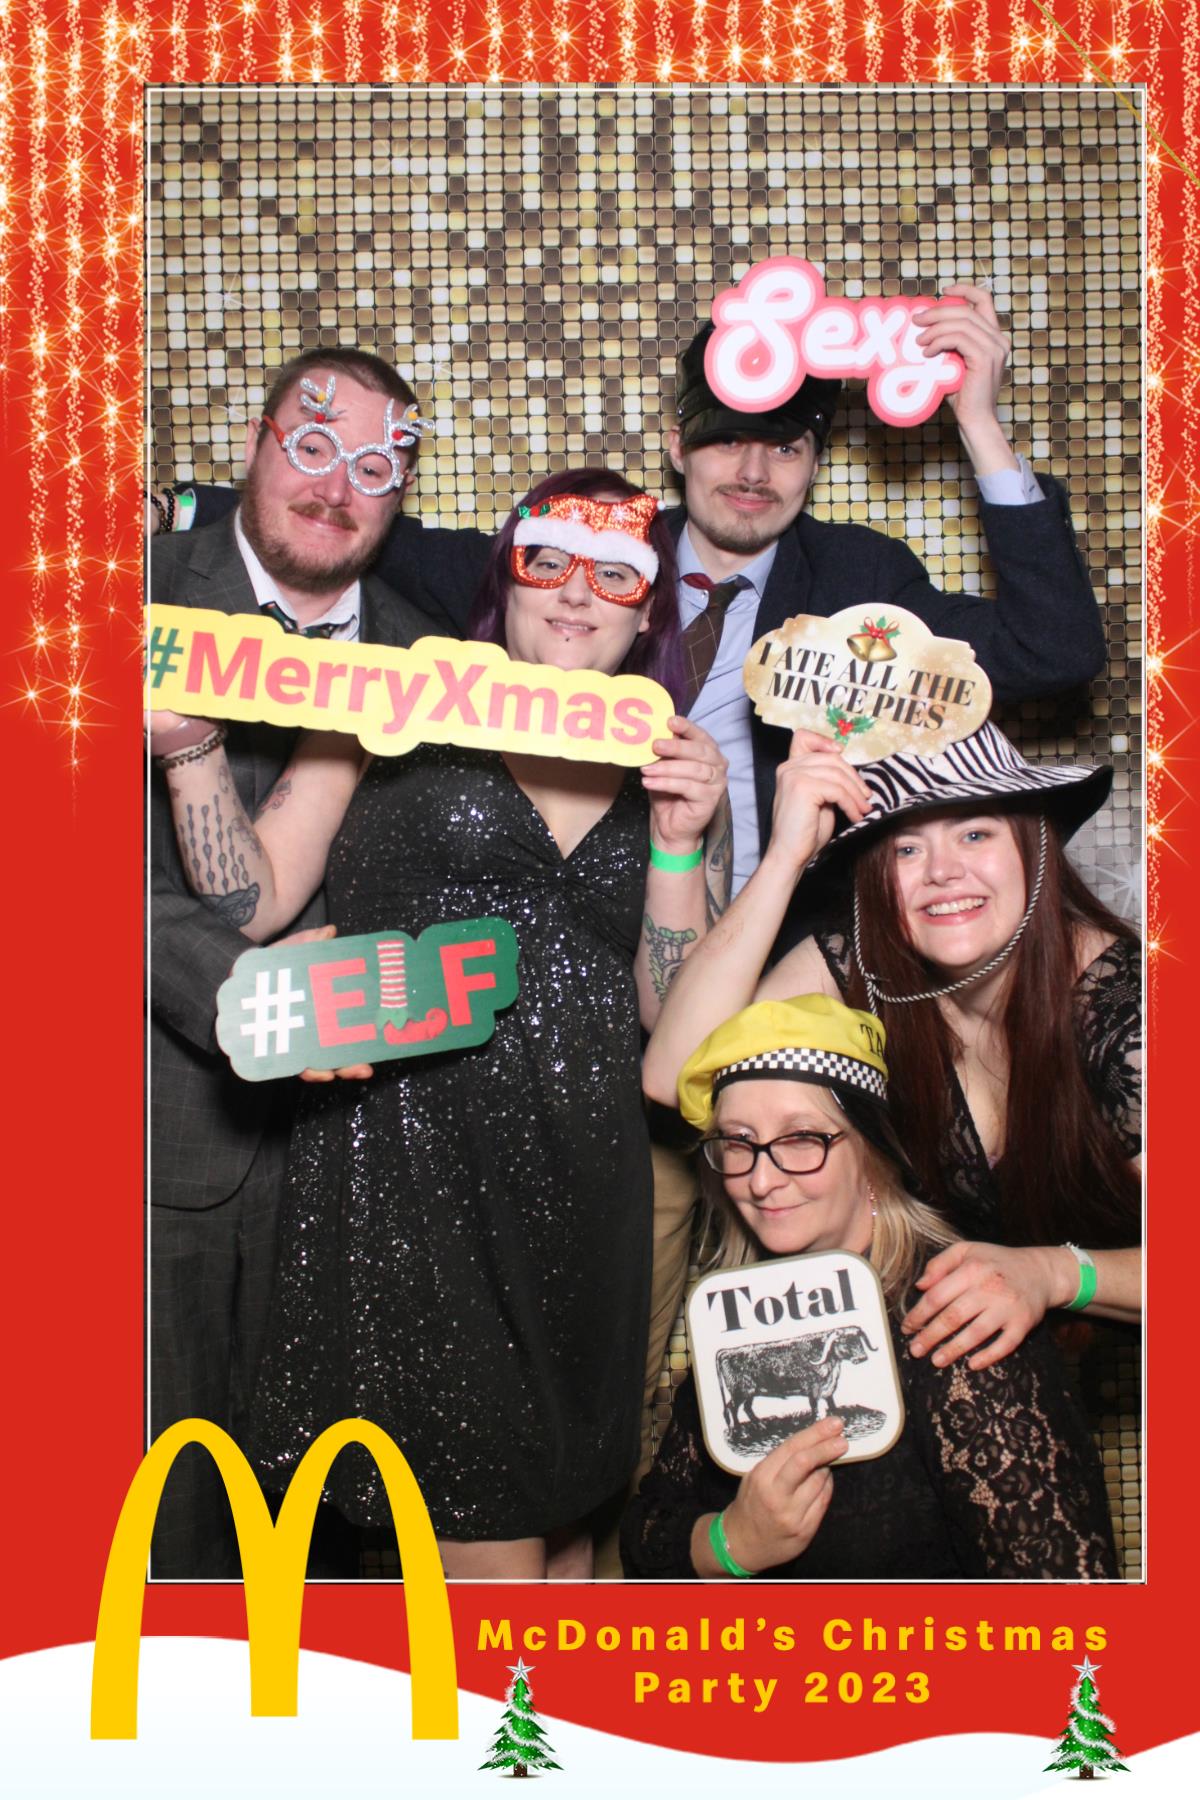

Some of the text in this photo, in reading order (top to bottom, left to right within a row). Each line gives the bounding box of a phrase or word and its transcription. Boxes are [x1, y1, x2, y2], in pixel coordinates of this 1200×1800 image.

[716, 266, 957, 414] Sexy
[145, 626, 653, 746] #MerryXmas
[758, 642, 977, 706] I ATE ALL THE
[767, 672, 947, 730] MINCE PIES
[706, 1268, 859, 1334] Total
